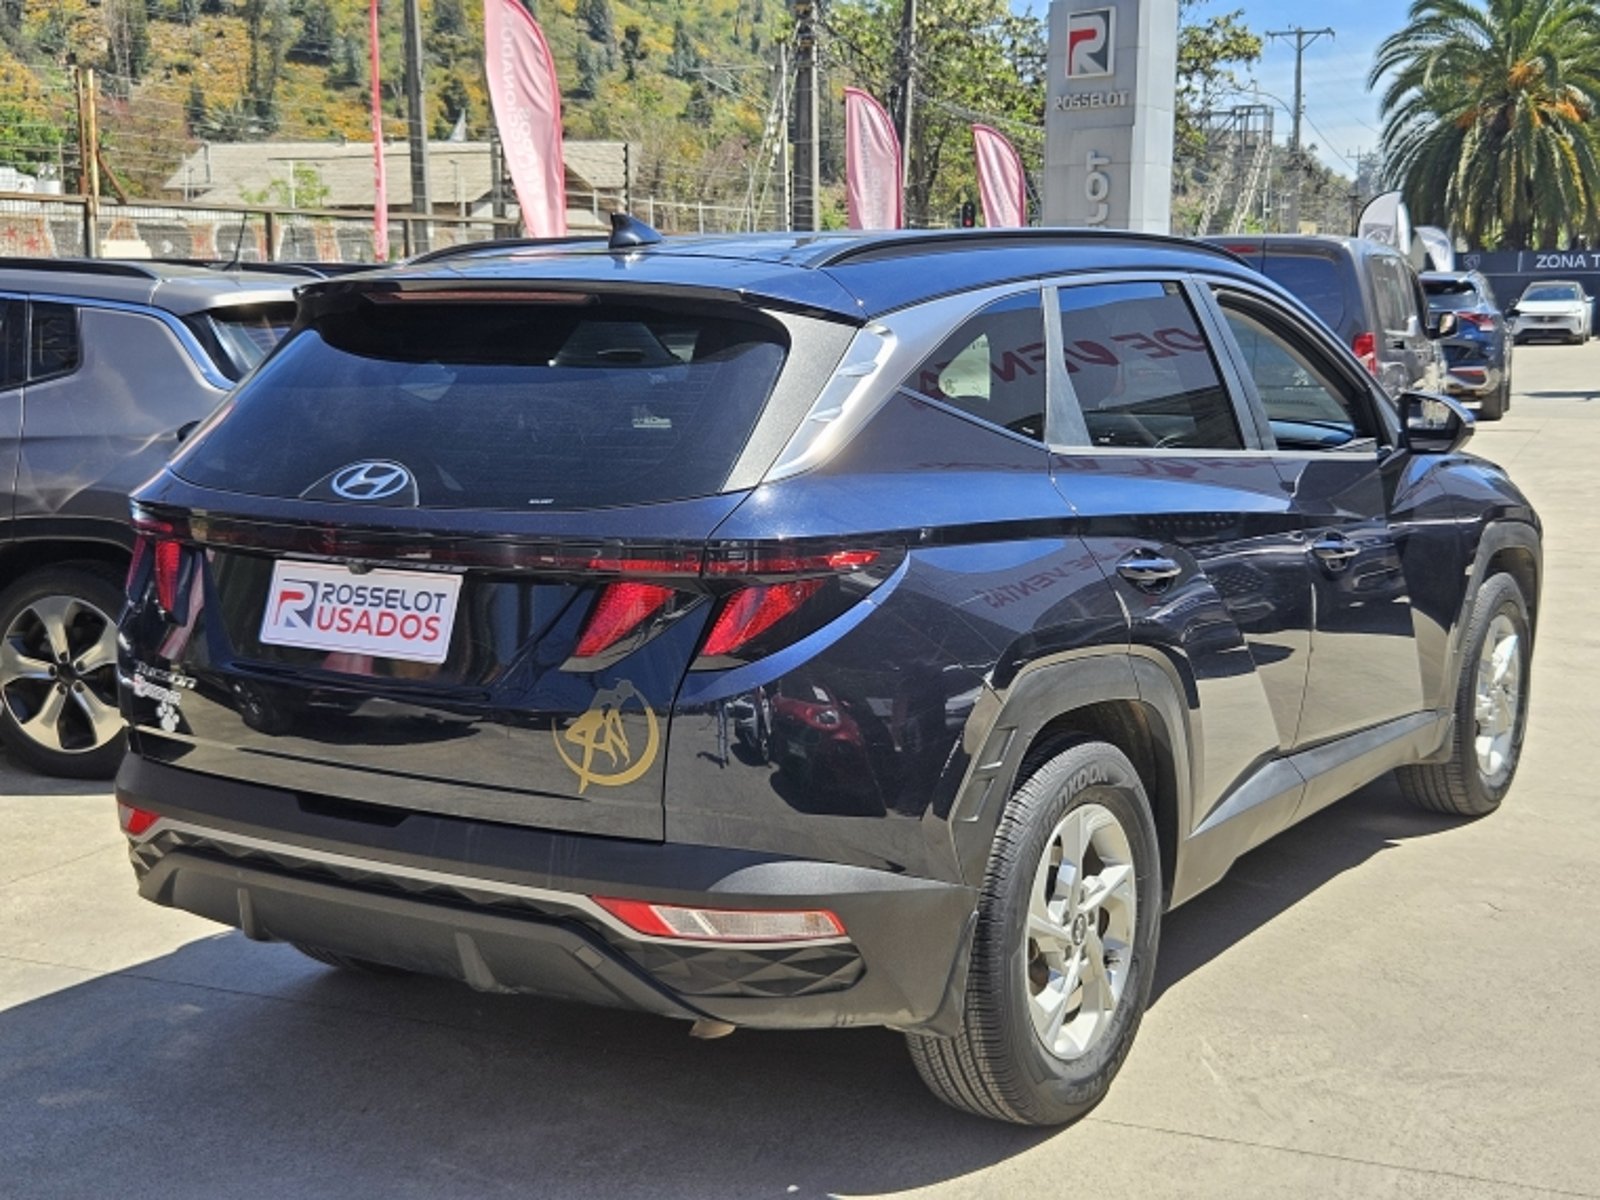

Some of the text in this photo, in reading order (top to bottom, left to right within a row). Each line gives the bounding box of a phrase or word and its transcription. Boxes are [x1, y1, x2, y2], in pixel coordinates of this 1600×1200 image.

[1054, 91, 1128, 111] ROSSELOT
[1085, 150, 1110, 229] LOT
[1536, 254, 1586, 268] ZONA
[320, 583, 447, 613] ROSSELOT
[316, 606, 442, 642] USADOS
